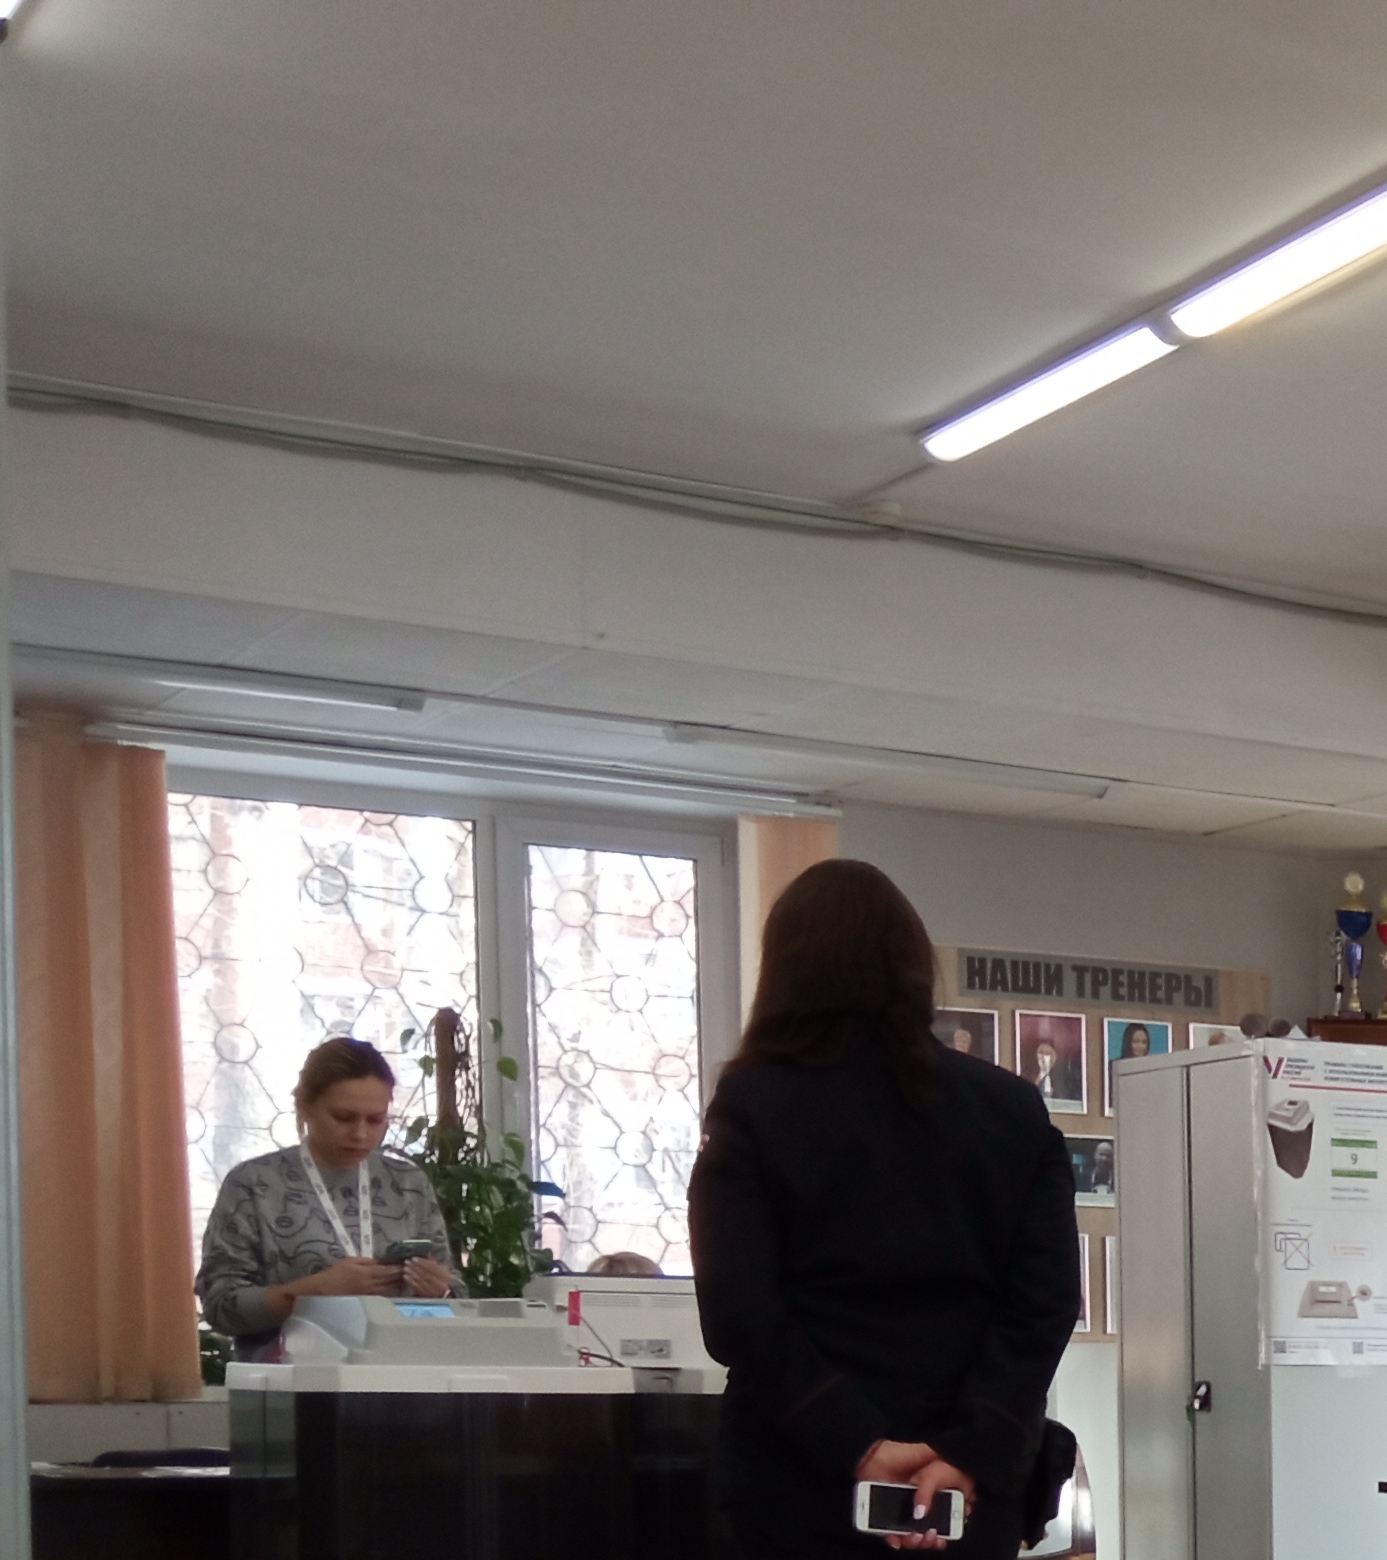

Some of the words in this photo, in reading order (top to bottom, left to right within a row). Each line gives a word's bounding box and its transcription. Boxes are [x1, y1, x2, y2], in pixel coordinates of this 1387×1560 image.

[966, 956, 1063, 997] НАШИ
[1071, 964, 1213, 1008] ТРЕНЕРЫ
[1350, 1153, 1358, 1165] 9
